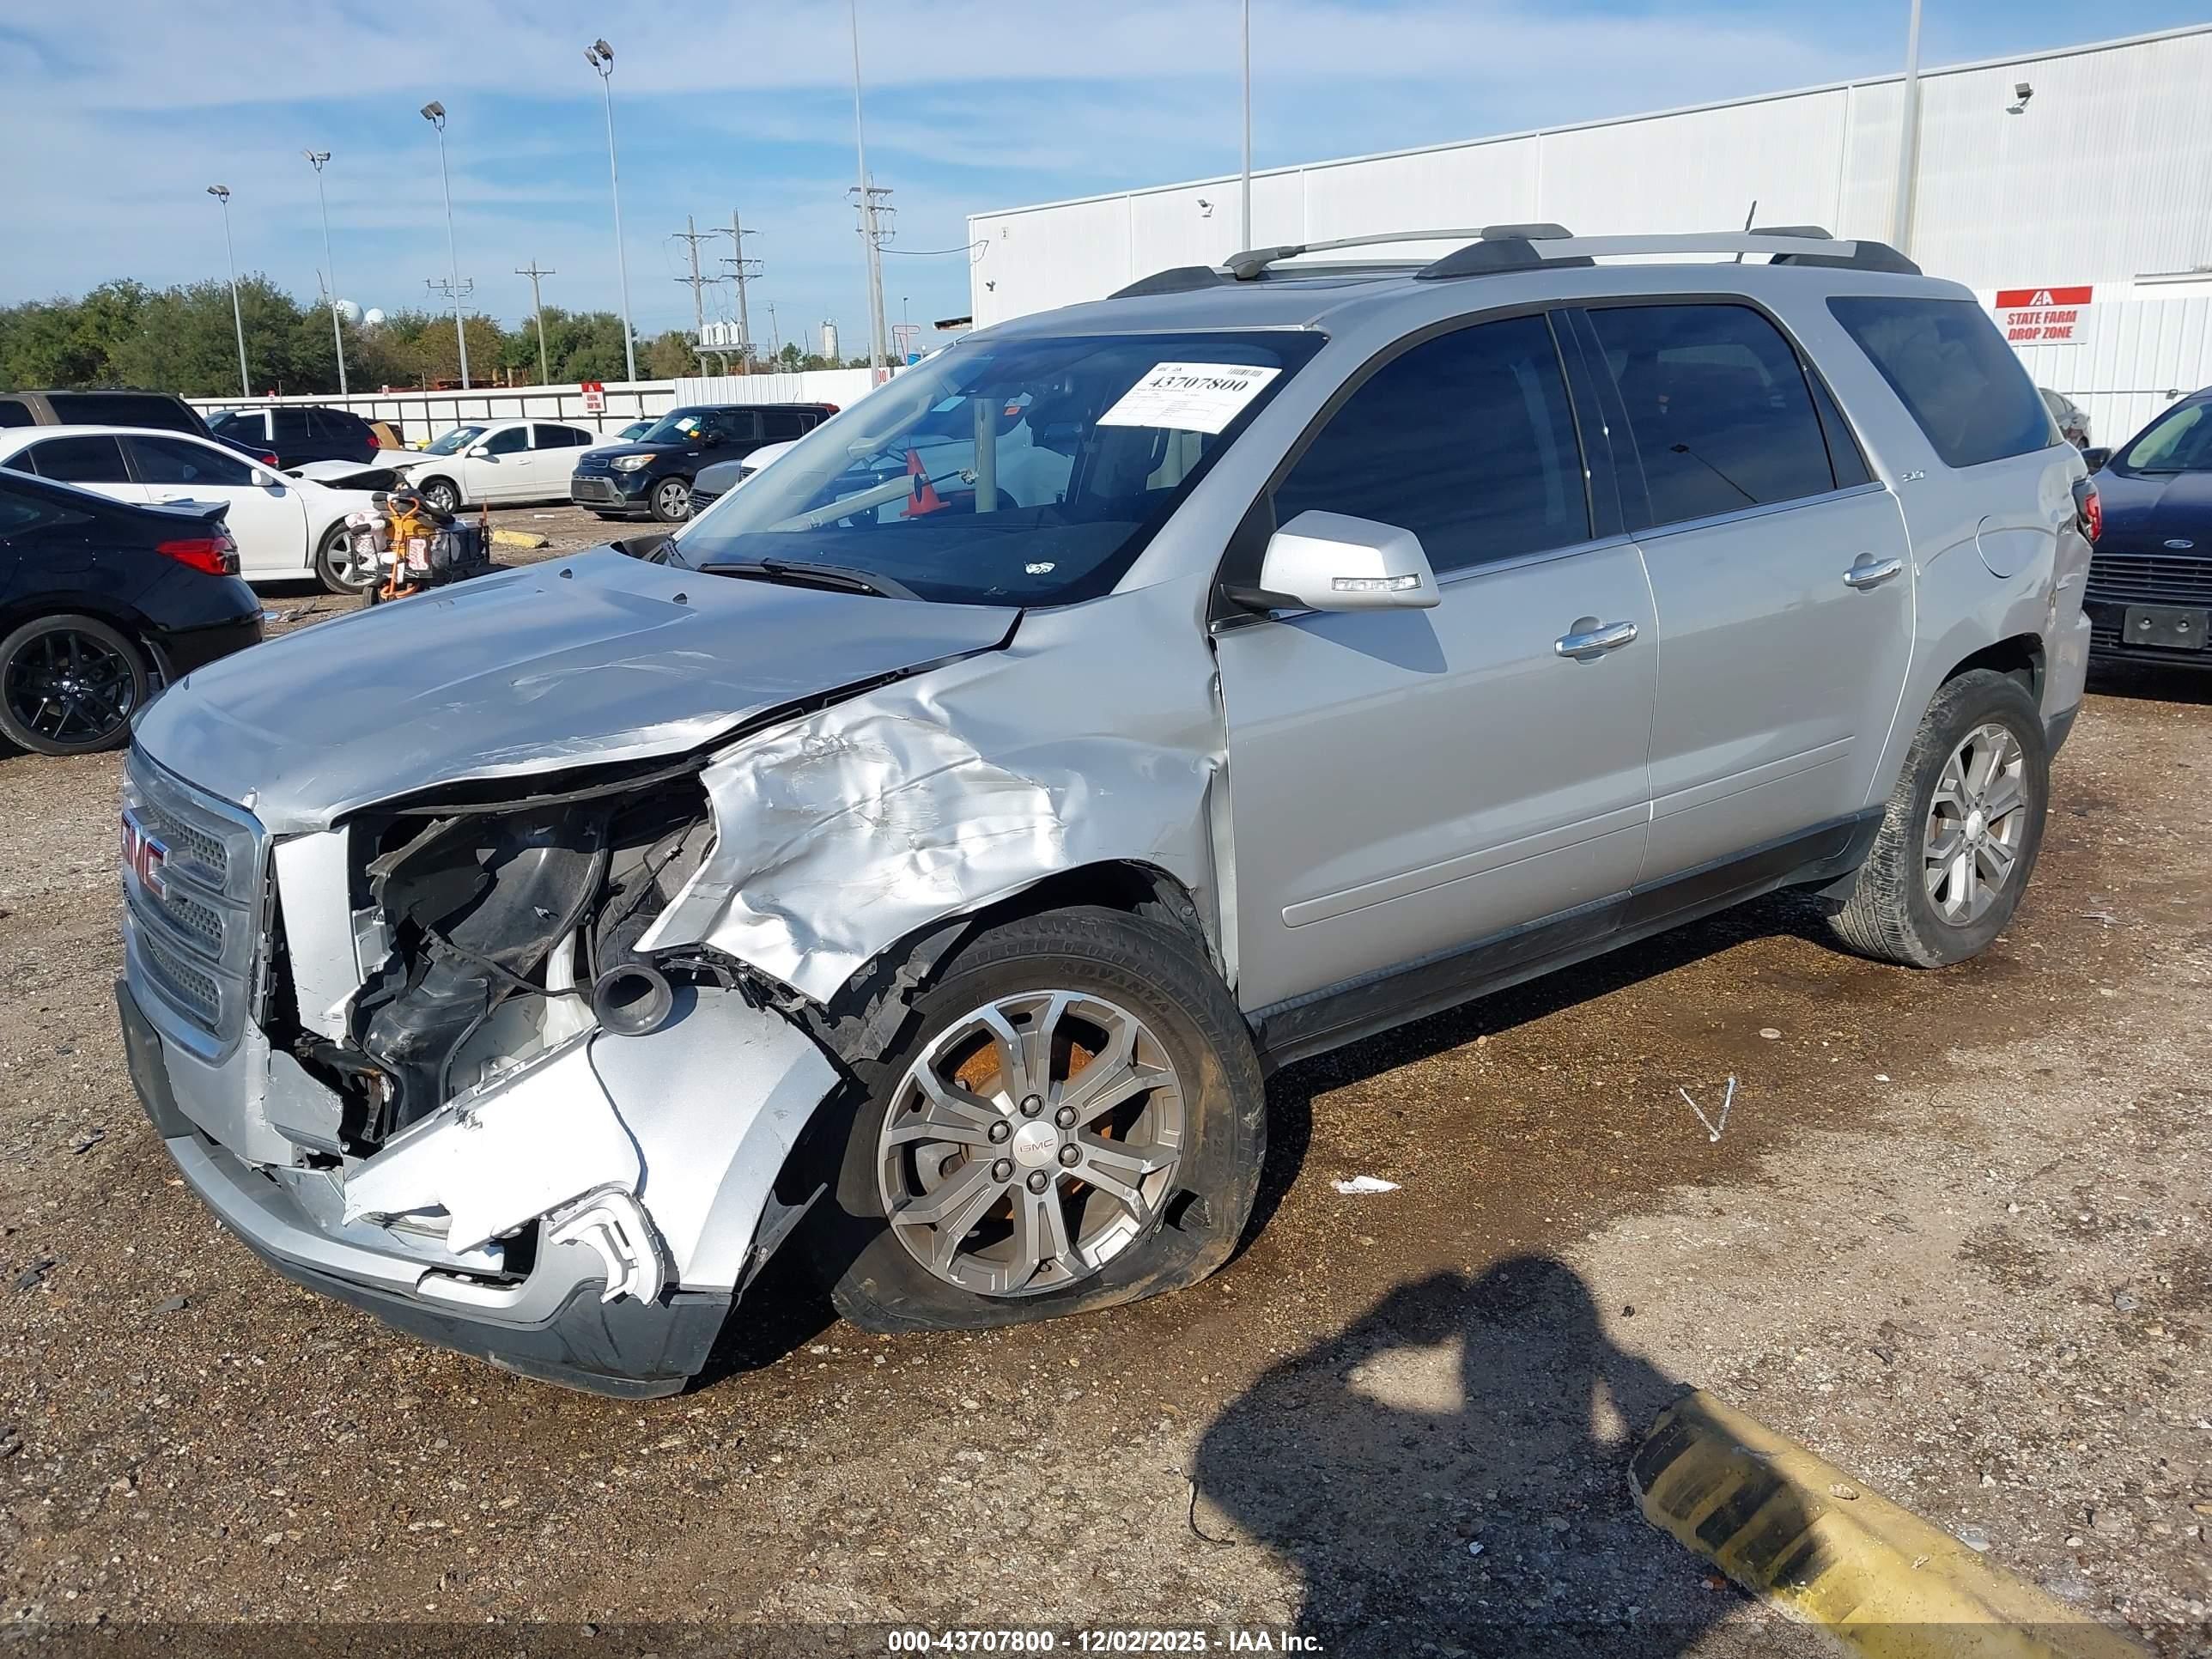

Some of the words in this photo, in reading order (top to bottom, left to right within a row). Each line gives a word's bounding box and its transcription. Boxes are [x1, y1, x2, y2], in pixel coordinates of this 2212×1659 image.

[2007, 312, 2043, 325] STATE
[2043, 310, 2077, 324] FARM
[2008, 327, 2041, 341] DROP
[2042, 326, 2074, 339] ZONE
[1149, 375, 1249, 393] 43707800
[1019, 1138, 1054, 1152] GMC
